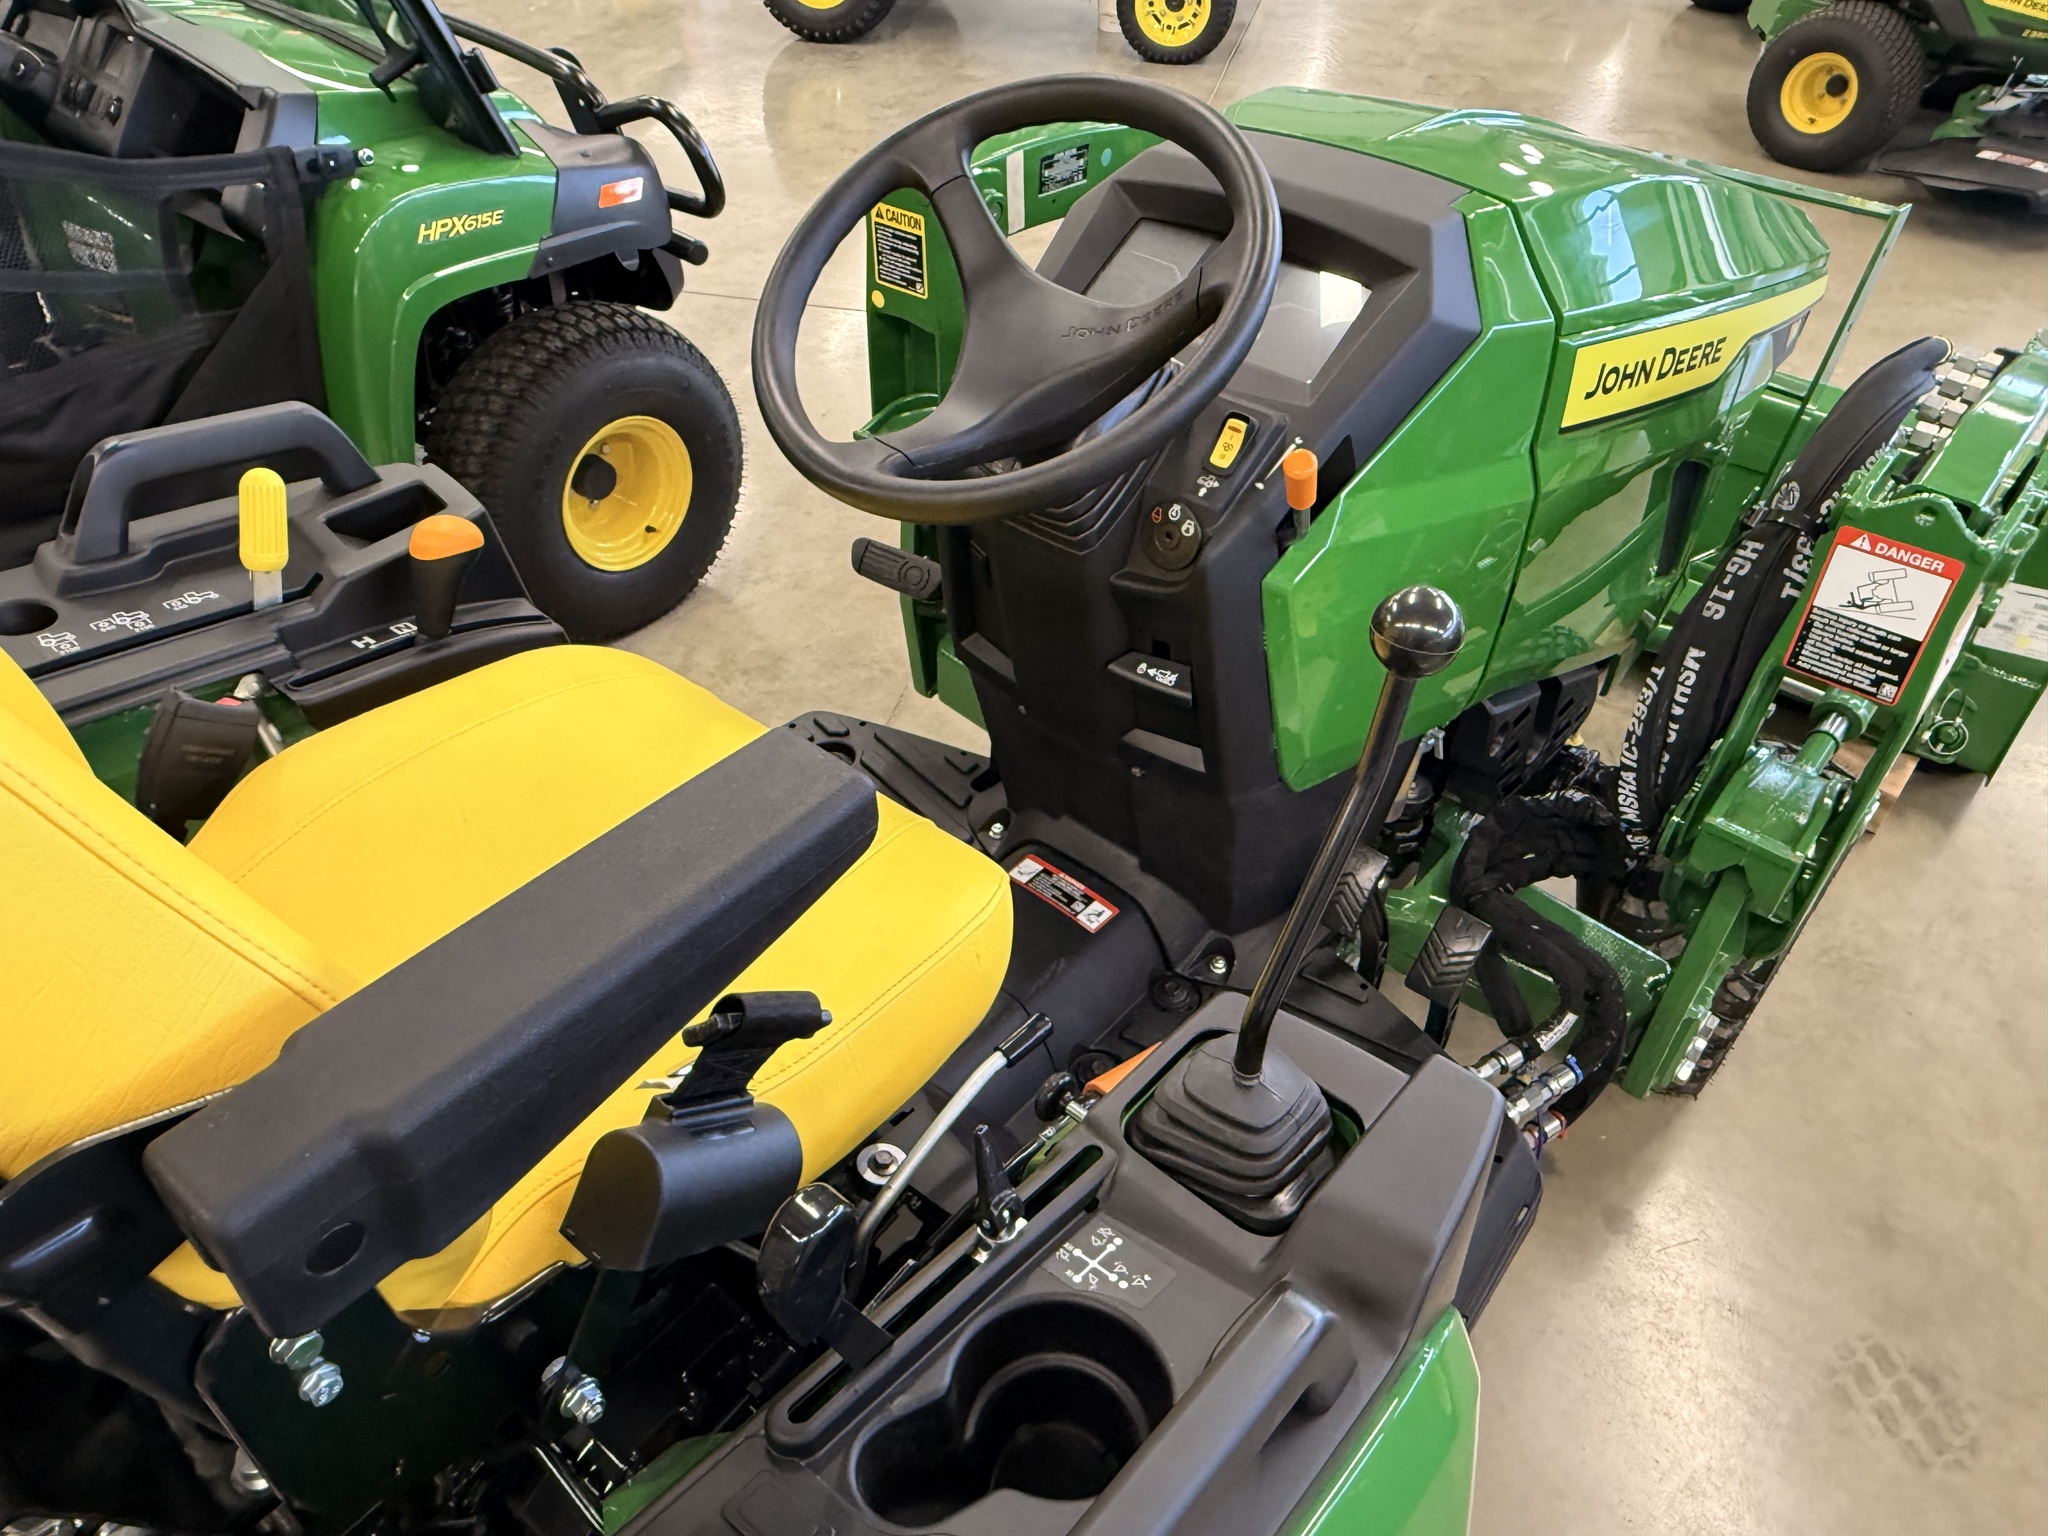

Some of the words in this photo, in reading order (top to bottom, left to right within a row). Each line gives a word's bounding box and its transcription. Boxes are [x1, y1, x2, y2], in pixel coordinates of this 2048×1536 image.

[417, 209, 505, 244] HPX615E
[885, 208, 922, 231] CAUTION
[1584, 356, 1657, 401] JOHN
[1656, 336, 1728, 382] DEERE
[1702, 539, 1765, 620] HG-16
[1874, 542, 1946, 573] DANGER
[1617, 770, 1641, 823] MSHA
